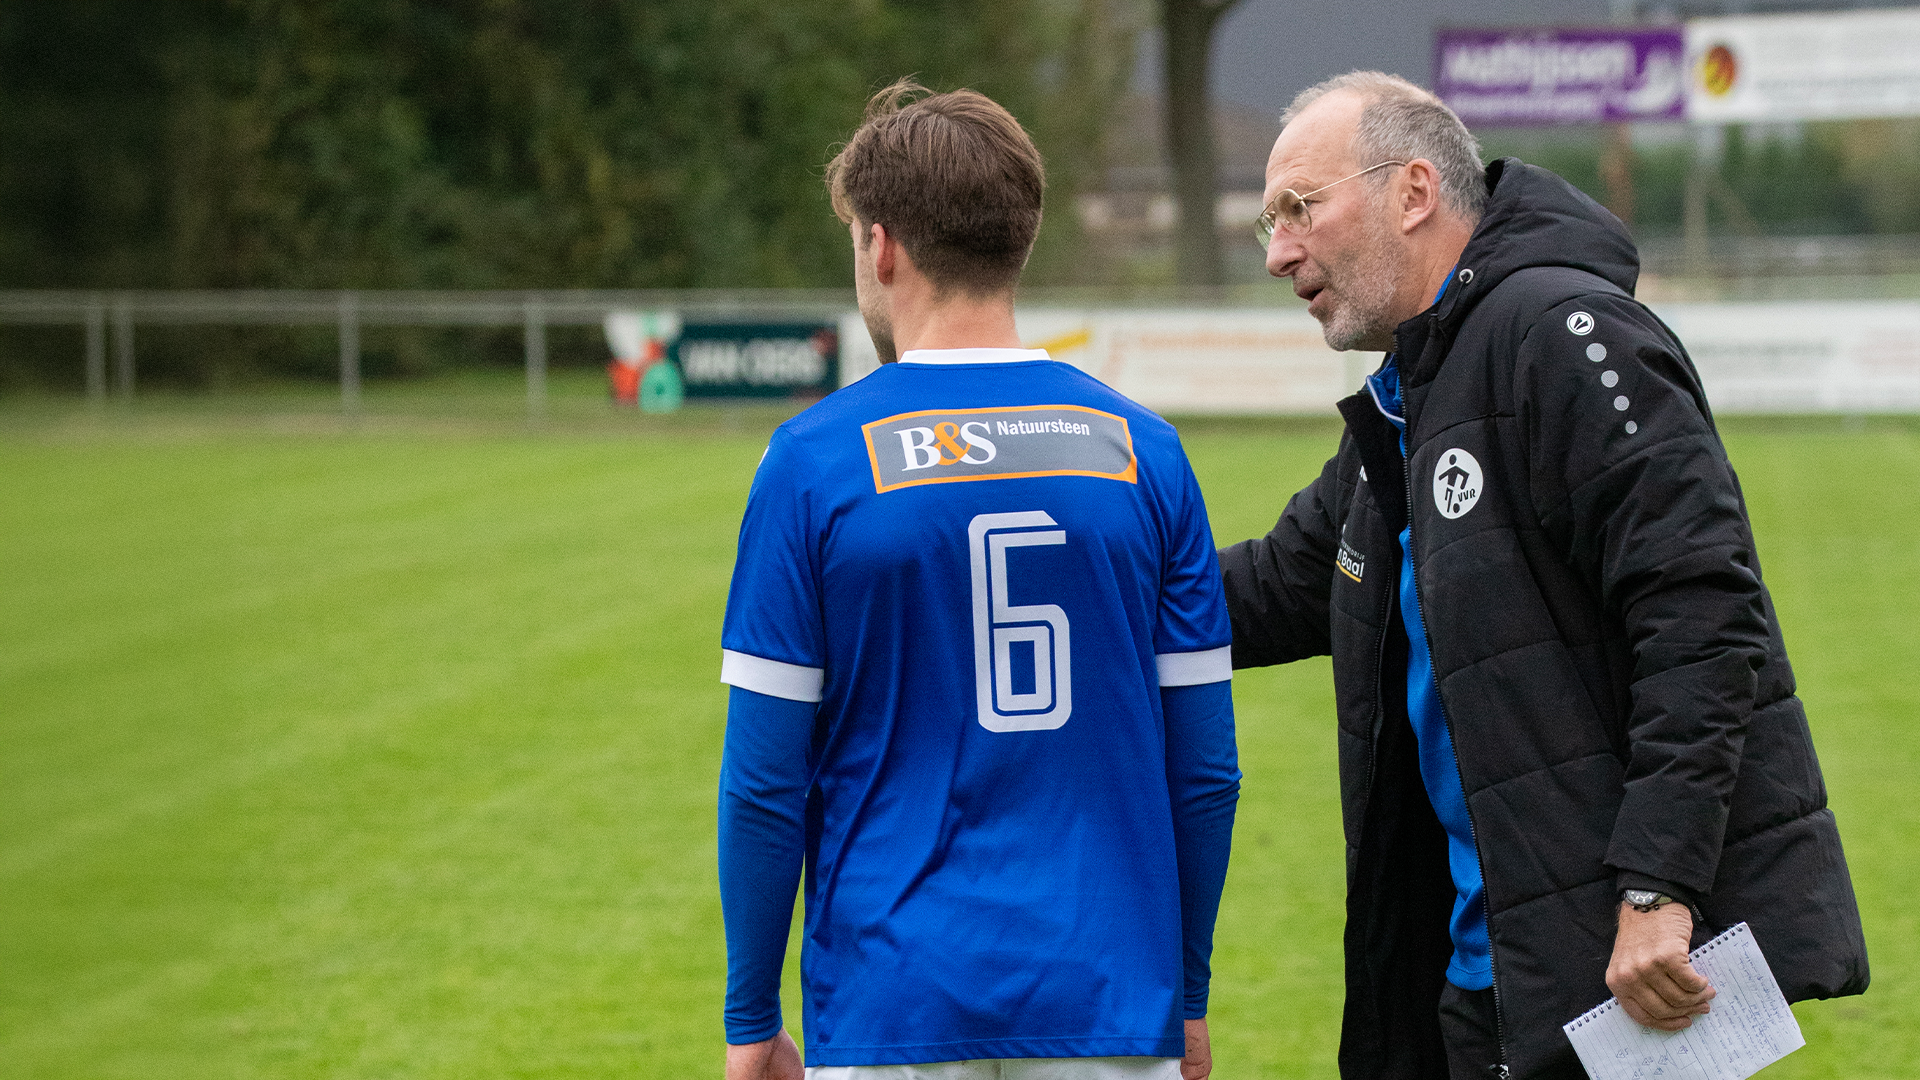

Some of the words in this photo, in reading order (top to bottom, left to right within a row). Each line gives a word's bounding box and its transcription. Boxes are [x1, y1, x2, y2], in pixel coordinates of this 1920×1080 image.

[894, 421, 997, 472] B&S
[997, 418, 1090, 436] Natuursteen
[1457, 488, 1476, 502] VVR
[1341, 550, 1365, 578] Baal
[968, 510, 1072, 733] 6
